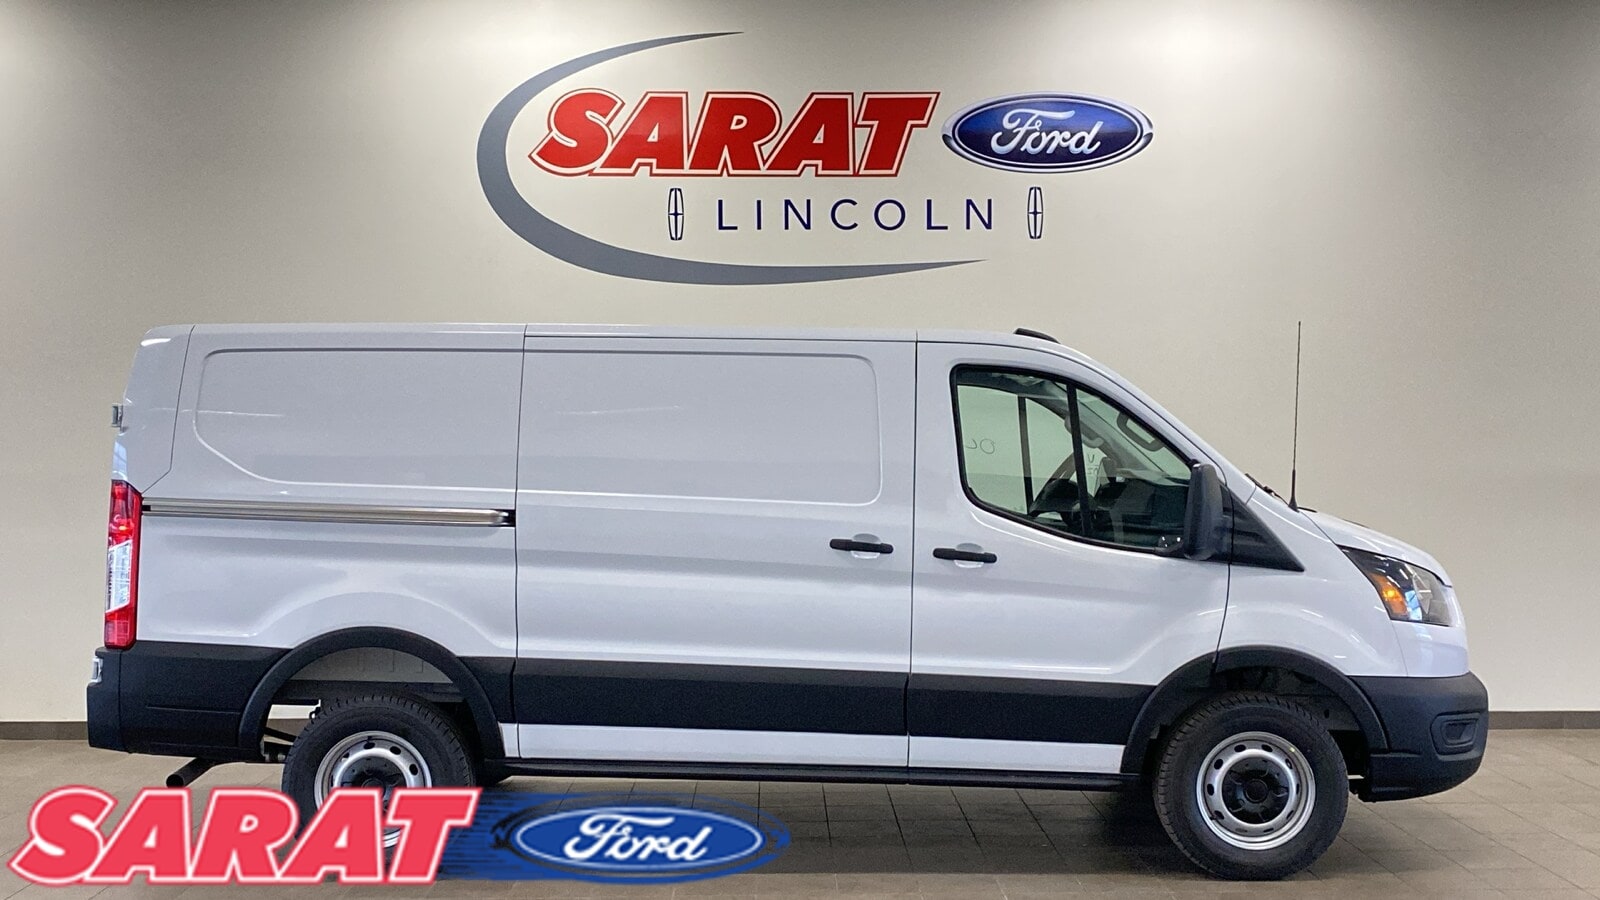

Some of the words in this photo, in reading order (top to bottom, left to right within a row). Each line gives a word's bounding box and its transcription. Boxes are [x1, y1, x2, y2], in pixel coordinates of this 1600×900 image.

[529, 88, 940, 177] SARAT
[990, 108, 1104, 155] Ford
[718, 198, 994, 231] LINCOLN
